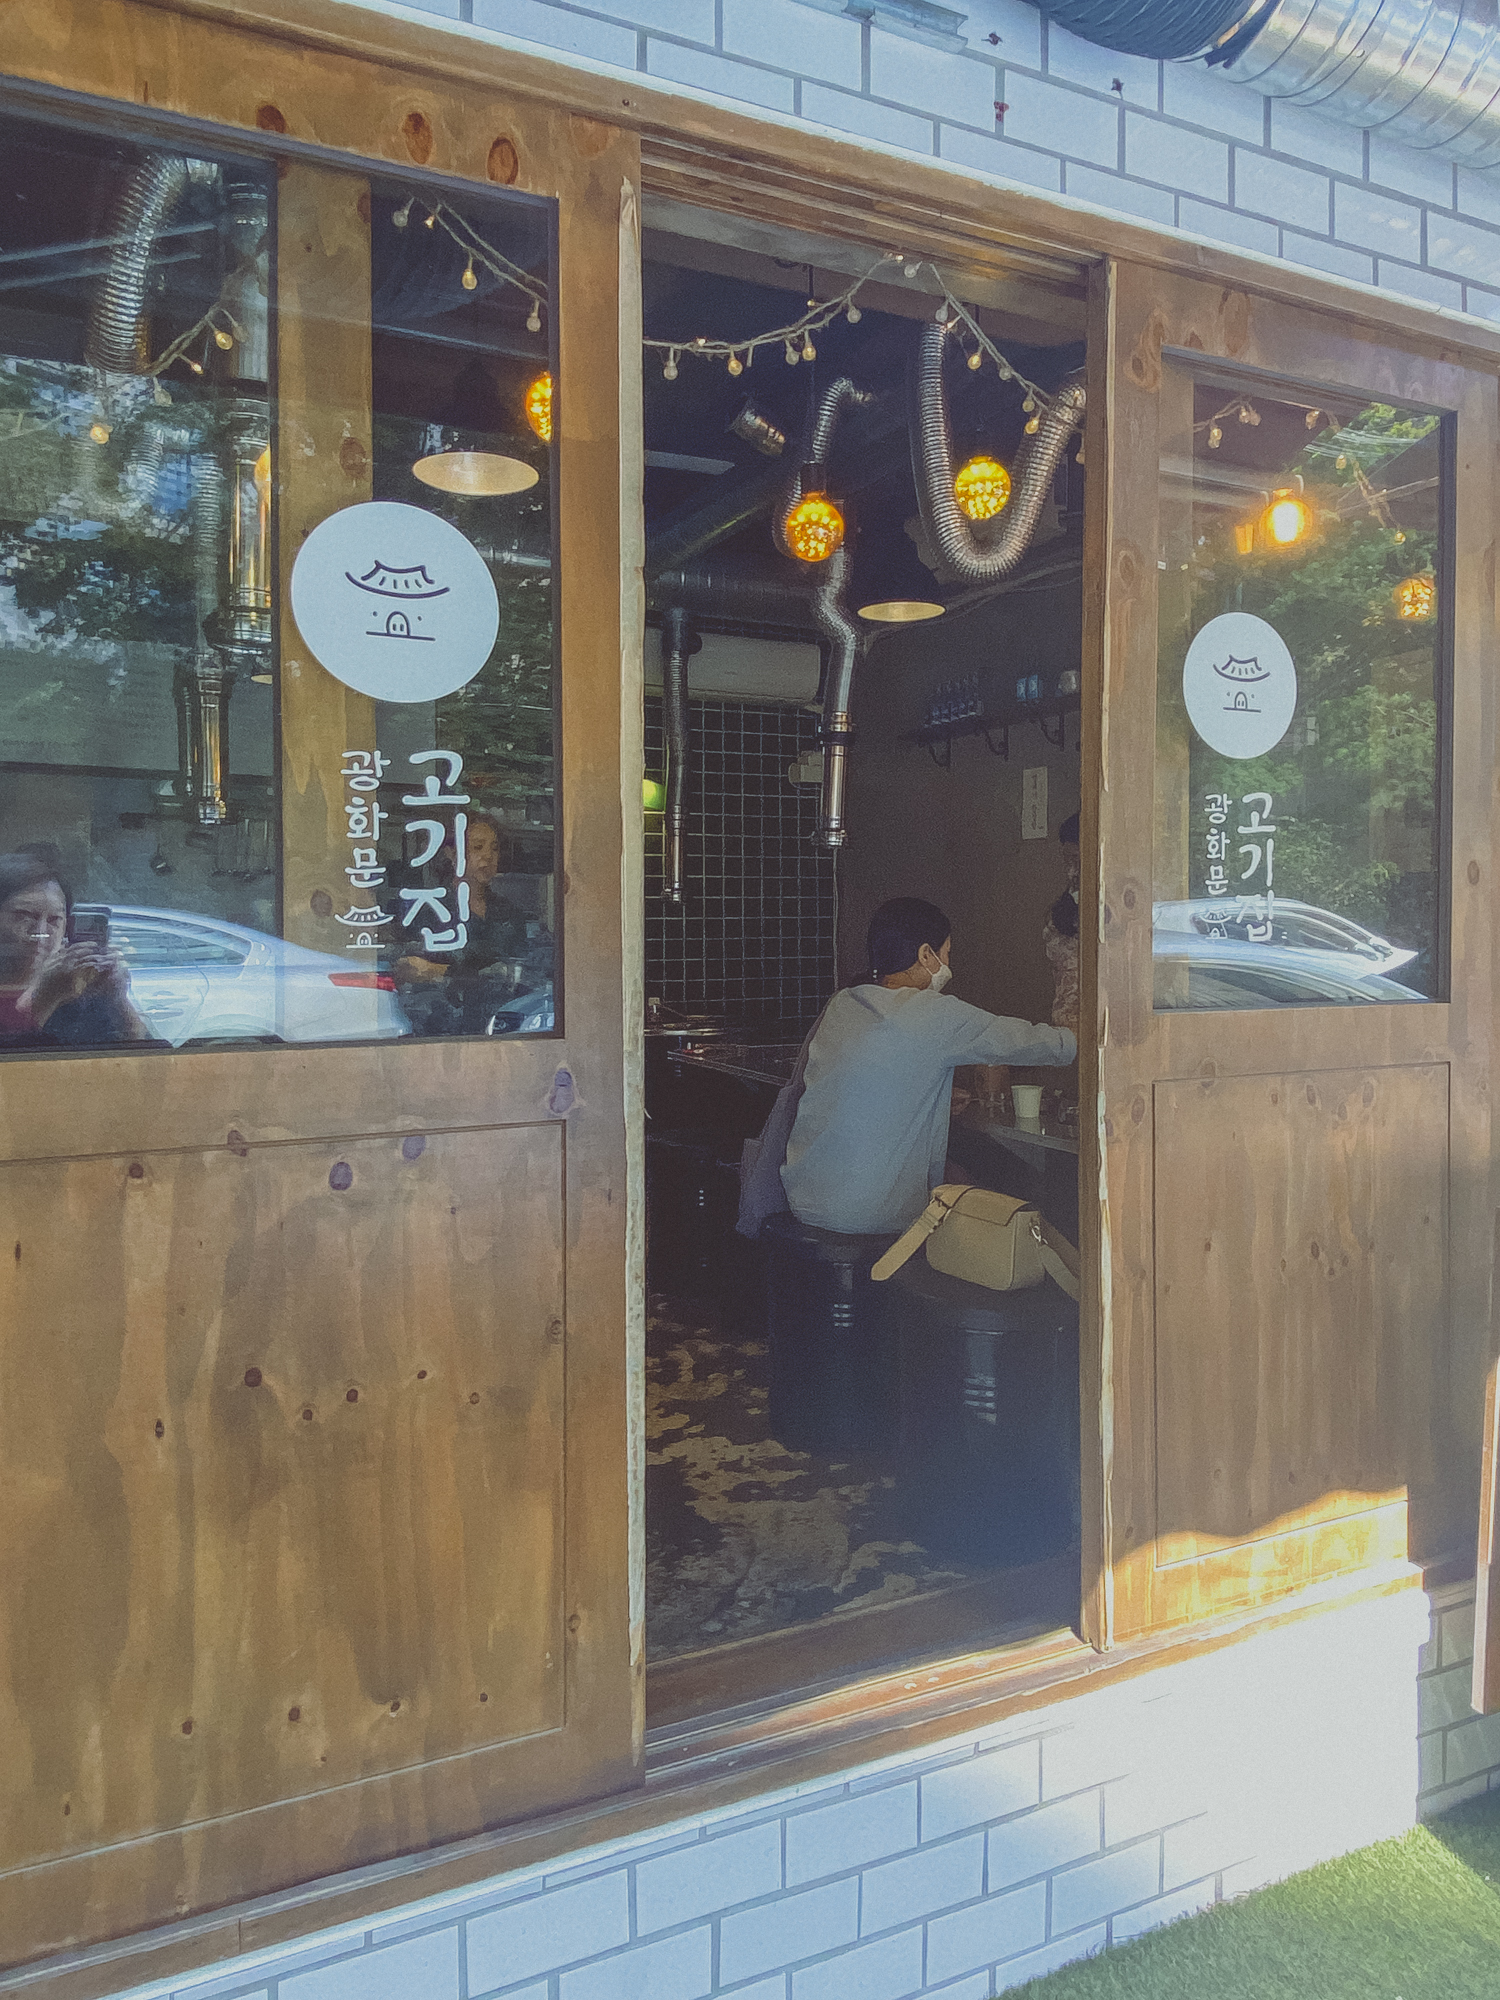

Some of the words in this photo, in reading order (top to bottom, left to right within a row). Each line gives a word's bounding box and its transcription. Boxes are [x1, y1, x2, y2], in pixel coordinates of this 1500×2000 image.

[340, 750, 391, 888] 광화문
[400, 750, 471, 951] 고기집
[1204, 793, 1233, 895] 광화문
[1235, 792, 1277, 942] 고기집
